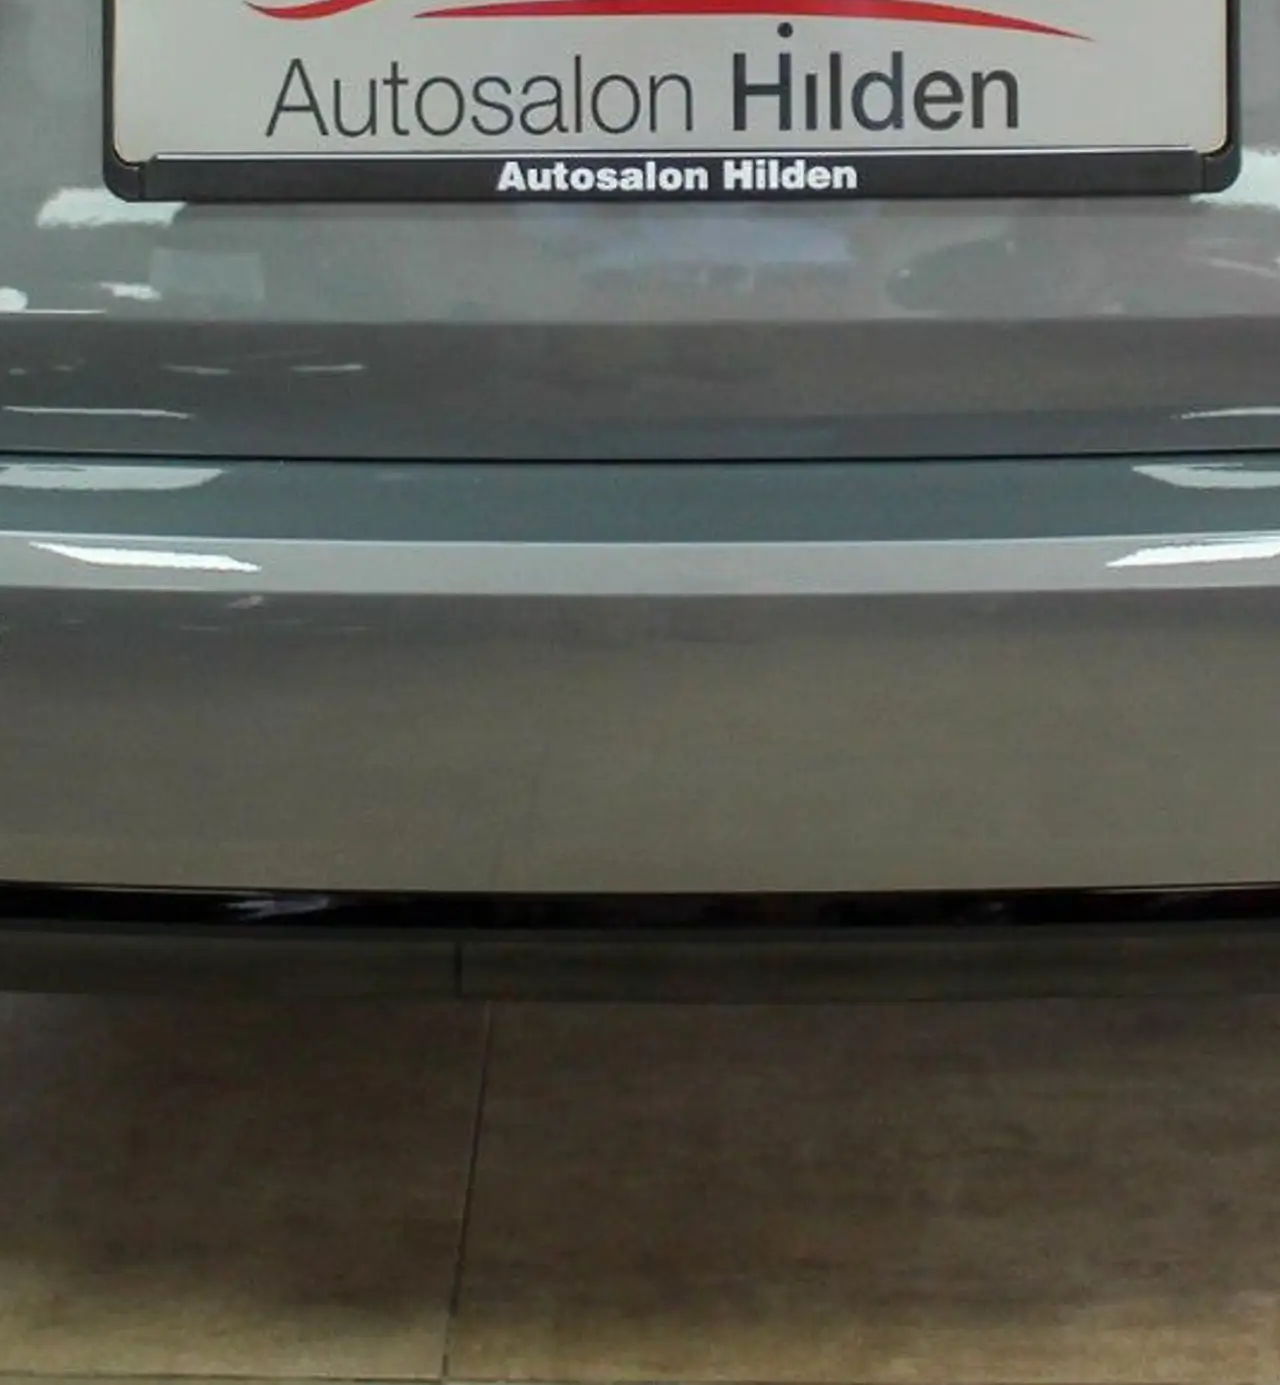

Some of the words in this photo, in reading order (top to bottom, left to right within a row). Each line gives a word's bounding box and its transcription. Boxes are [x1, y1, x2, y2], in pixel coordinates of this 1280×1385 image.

[265, 54, 694, 138] Autosalon
[732, 21, 1020, 132] Hilden
[496, 161, 709, 191] Autosalon
[723, 159, 857, 189] Hilden
